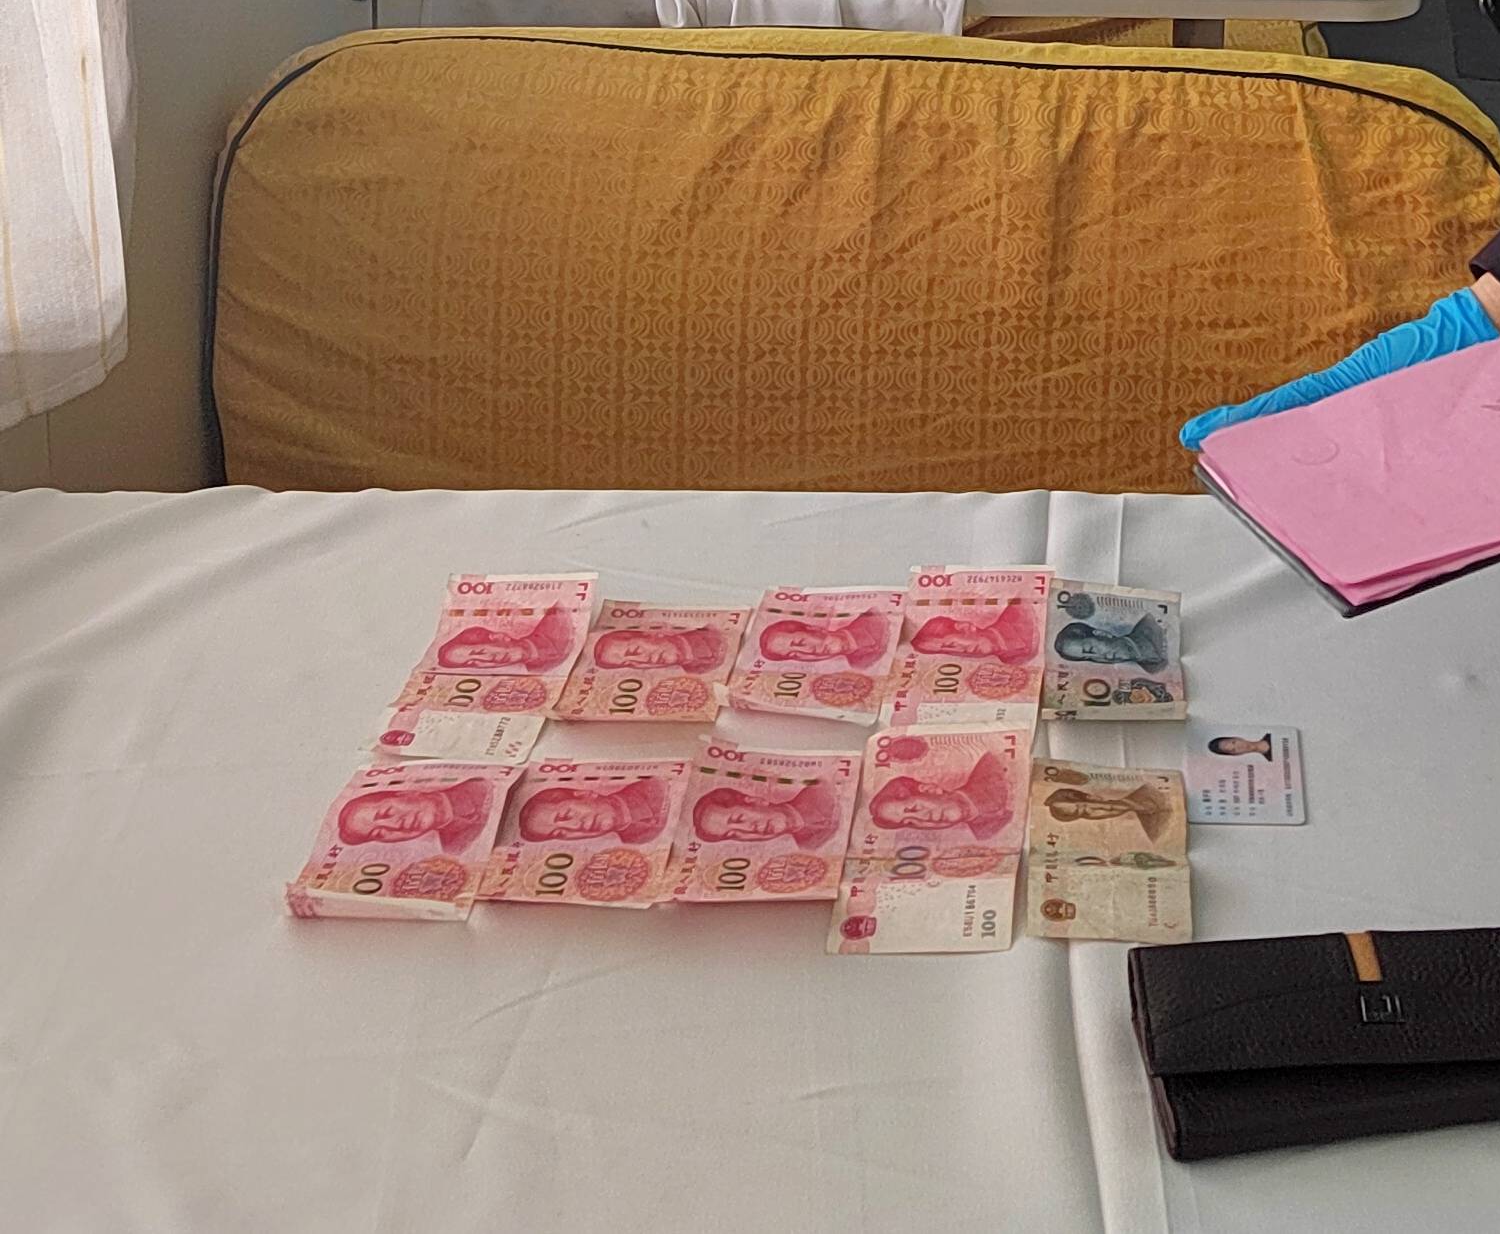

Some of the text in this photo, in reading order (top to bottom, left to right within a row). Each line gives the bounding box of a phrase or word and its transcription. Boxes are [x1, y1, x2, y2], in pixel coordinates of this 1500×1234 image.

[458, 581, 494, 594] 100
[918, 574, 952, 587] 100
[1057, 591, 1071, 609] 10
[773, 672, 806, 698] 100
[933, 663, 961, 694] 100
[609, 678, 643, 715] 100
[1083, 679, 1111, 707] 10
[708, 747, 745, 761] 100
[875, 737, 891, 768] 100
[536, 853, 573, 896] 100
[716, 858, 750, 891] 100
[890, 846, 930, 880] 100
[981, 910, 996, 937] 100
